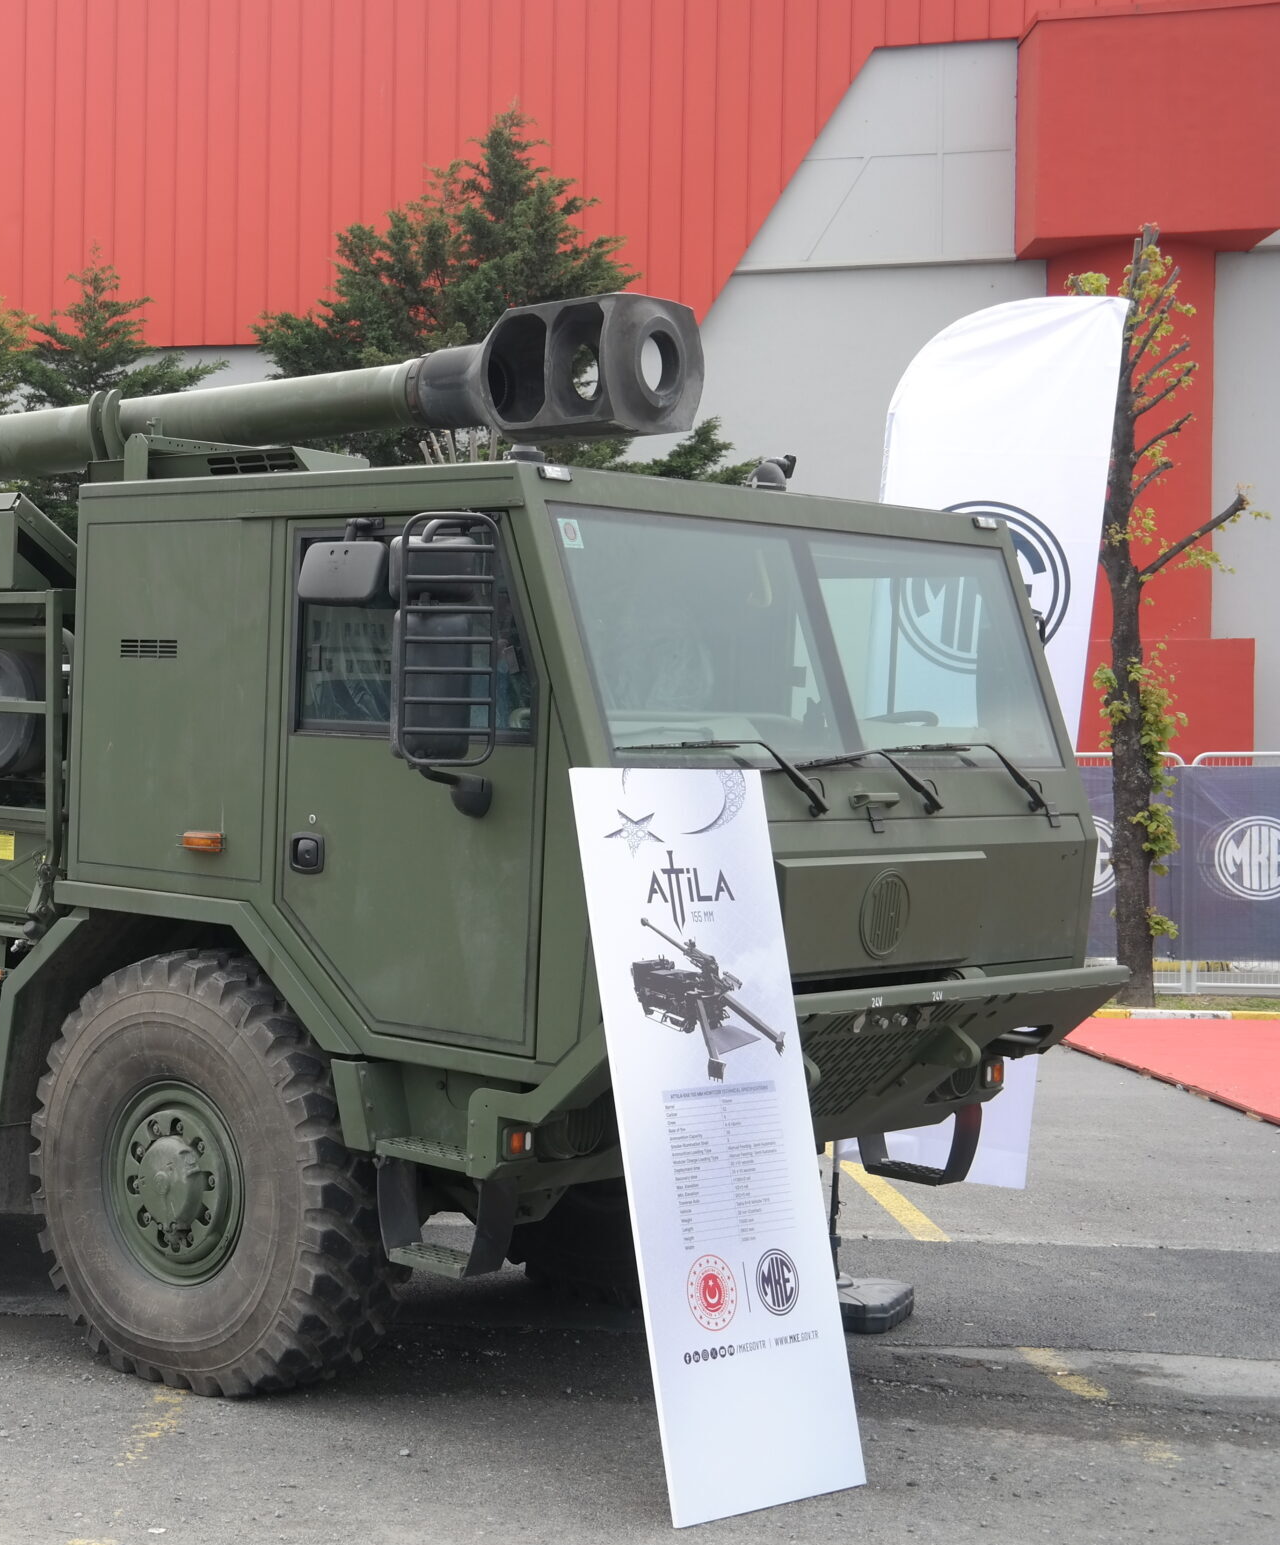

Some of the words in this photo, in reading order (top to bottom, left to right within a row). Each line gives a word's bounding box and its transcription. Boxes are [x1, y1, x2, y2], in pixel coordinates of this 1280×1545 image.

[691, 911, 702, 922] 155
[703, 910, 714, 922] MM
[871, 995, 883, 1007] 24V
[932, 991, 943, 1001] 24V
[761, 1257, 794, 1308] MKE
[775, 1330, 819, 1347] WWW.MKE.GOV.TR
